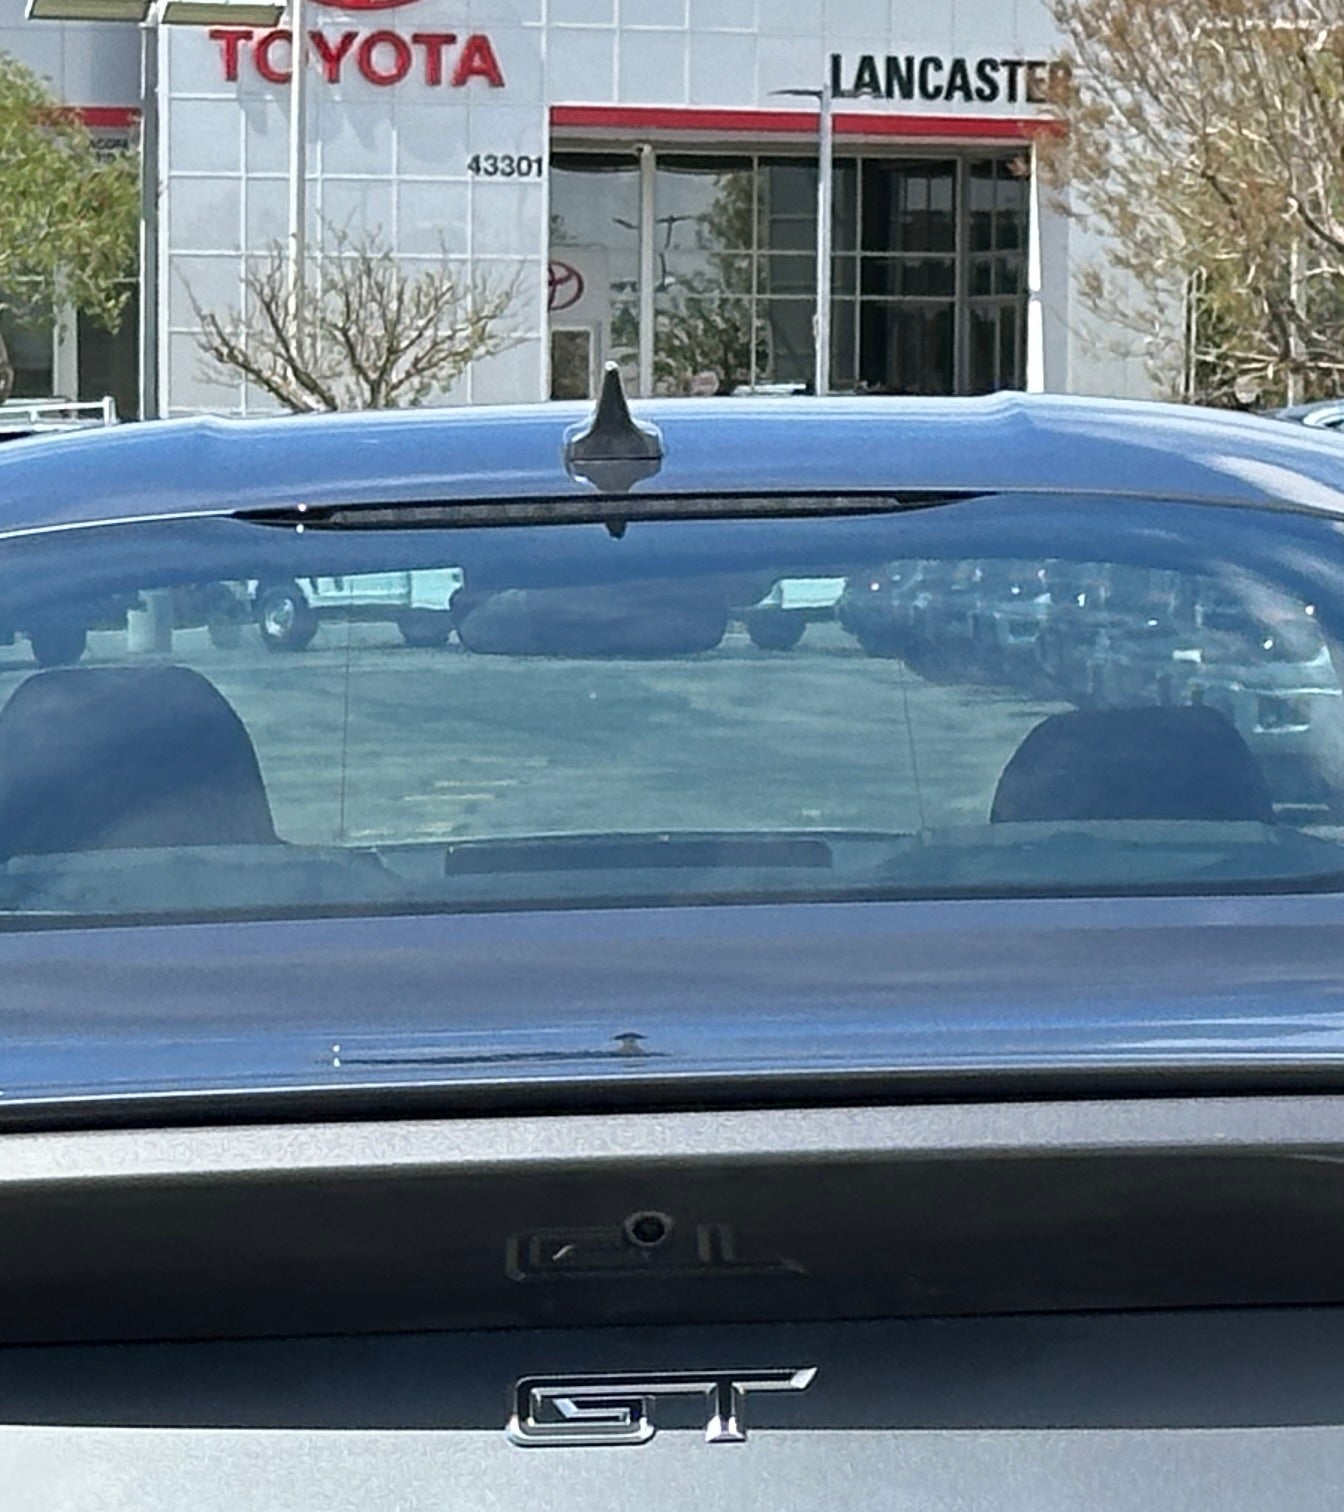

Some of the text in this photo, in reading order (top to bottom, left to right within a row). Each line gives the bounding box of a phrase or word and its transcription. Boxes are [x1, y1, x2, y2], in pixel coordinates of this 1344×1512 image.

[208, 29, 506, 88] TOYOTA
[466, 154, 544, 178] 43301
[506, 1366, 818, 1446] GT
